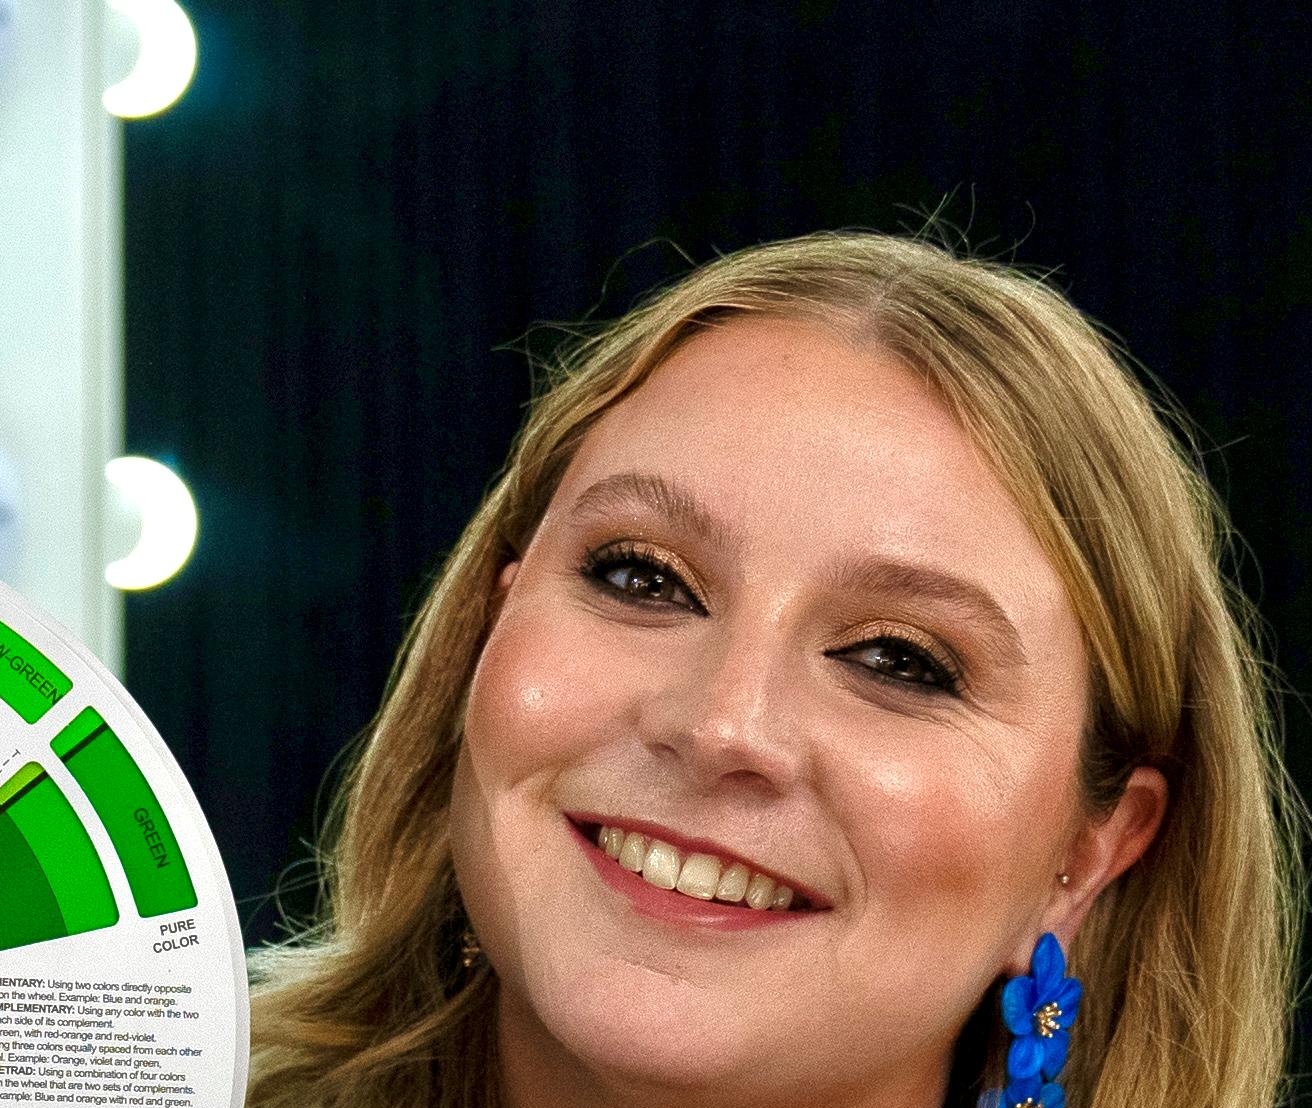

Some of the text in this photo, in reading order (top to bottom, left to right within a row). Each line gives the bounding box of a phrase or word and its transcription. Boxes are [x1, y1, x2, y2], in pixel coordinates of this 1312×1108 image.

[133, 807, 170, 868] GREEN
[160, 919, 196, 936] PURE
[153, 935, 199, 953] COLOR
[47, 979, 73, 991] Using
[74, 980, 90, 989] two
[92, 981, 119, 990] colors
[121, 982, 152, 994] directly
[154, 983, 191, 995] opposite
[11, 991, 25, 999] the
[27, 992, 56, 1000] wheel.
[59, 993, 100, 1004] Example:
[102, 995, 122, 1003] Blue
[124, 996, 141, 1004] and
[143, 998, 177, 1007] orange.
[77, 1006, 102, 1017] Using
[104, 1009, 121, 1018] any
[123, 1008, 145, 1017] color
[147, 1008, 164, 1017] with
[166, 1009, 181, 1018] the
[182, 1010, 198, 1019] two
[14, 1016, 32, 1024] side
[34, 1017, 43, 1025] of
[45, 1017, 55, 1025] its
[57, 1017, 114, 1029] complement.
[24, 1028, 42, 1037] with
[44, 1029, 92, 1041] red-orange
[95, 1031, 112, 1040] and
[114, 1031, 156, 1041] red-violet.
[11, 1040, 34, 1050] three
[36, 1041, 63, 1051] colors
[64, 1042, 96, 1054] equally
[98, 1044, 130, 1055] spaced
[132, 1045, 153, 1054] from
[155, 1046, 177, 1055] each
[179, 1046, 202, 1056] other
[38, 1067, 64, 1078] Using
[73, 1068, 127, 1078] combination
[129, 1070, 138, 1079] of
[140, 1070, 157, 1080] four
[159, 1071, 185, 1081] colors
[4, 1078, 18, 1087] the
[20, 1079, 47, 1088] wheel
[49, 1080, 66, 1089] that
[84, 1081, 100, 1090] two
[102, 1082, 121, 1091] sets
[123, 1083, 132, 1091] of
[133, 1083, 195, 1096] complements.
[35, 1092, 54, 1101] Blue
[56, 1093, 73, 1102] and
[75, 1096, 107, 1105] orange
[108, 1095, 127, 1104] with
[129, 1096, 143, 1105] red
[145, 1097, 162, 1105] and
[164, 1099, 192, 1108] green.
